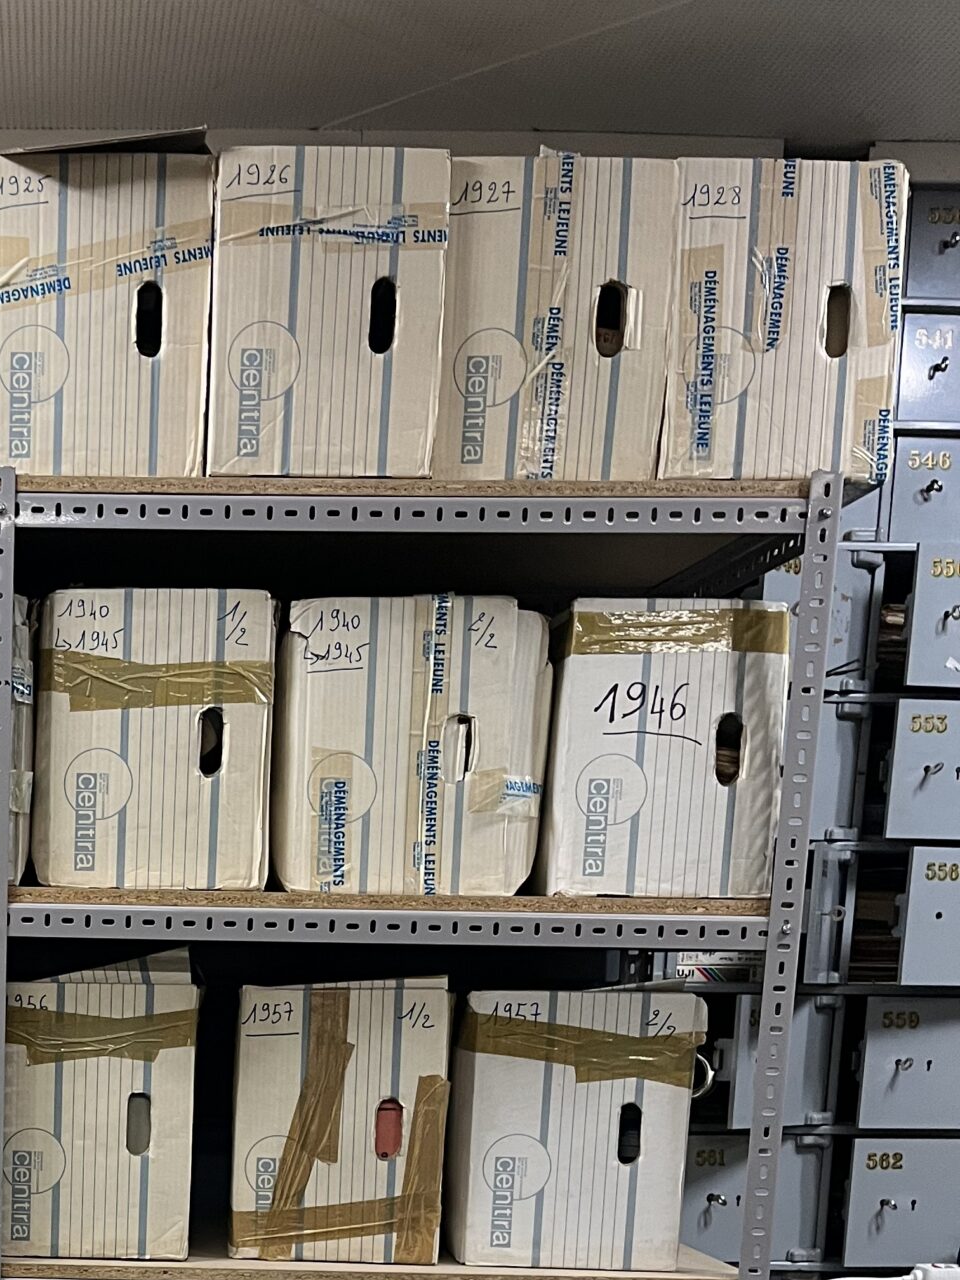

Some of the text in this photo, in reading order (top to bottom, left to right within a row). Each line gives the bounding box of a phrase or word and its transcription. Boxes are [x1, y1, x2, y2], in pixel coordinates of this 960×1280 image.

[226, 163, 291, 189] 1926
[451, 180, 517, 207] 1927
[681, 183, 742, 208] 1928
[553, 201, 572, 257] LEJEUNE
[883, 162, 901, 270] ÉMÉNAGEMENTS
[116, 253, 168, 278] LEJEUNE
[695, 270, 718, 450] DÉMÉNAGEMENTS LEJEUNE
[914, 328, 955, 350] 541
[9, 352, 33, 458] centra
[240, 348, 263, 458] centra
[461, 355, 490, 464] centra
[908, 450, 951, 470] 546
[58, 598, 110, 619] 1940
[217, 601, 250, 647] 1/2
[311, 608, 361, 639] 1940
[74, 628, 125, 651] 1945
[431, 642, 446, 695] LEJEUNE
[593, 680, 691, 730] 1946
[910, 714, 948, 733] 553
[424, 740, 443, 847] DÉMÉNAGEMENTS
[74, 772, 98, 872] centra
[332, 781, 349, 887] DÉMÉNAGEMENTS
[582, 777, 611, 877] centra
[676, 968, 696, 978] UJI
[241, 1001, 295, 1026] 1957
[397, 1001, 436, 1030] 1/2
[485, 1001, 542, 1029] 1957
[10, 1150, 32, 1242] centra
[489, 1156, 516, 1248] centra
